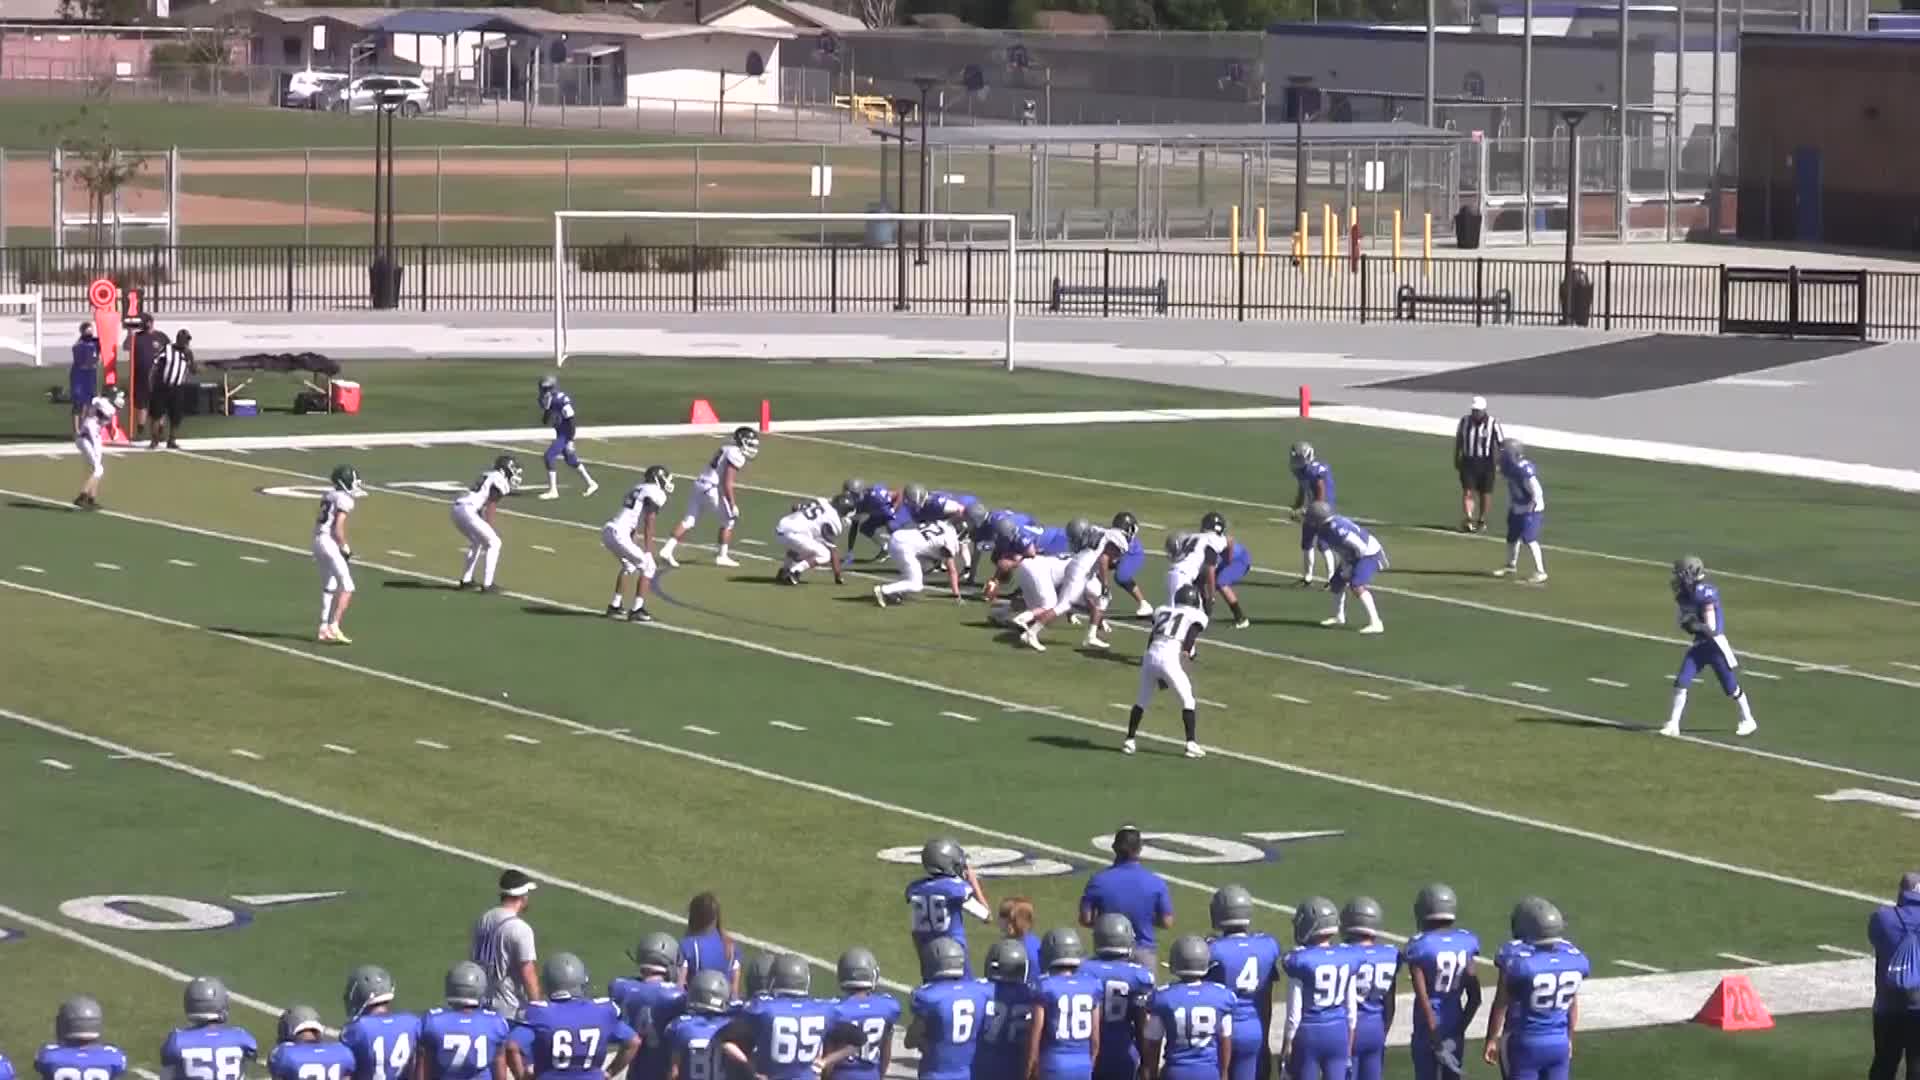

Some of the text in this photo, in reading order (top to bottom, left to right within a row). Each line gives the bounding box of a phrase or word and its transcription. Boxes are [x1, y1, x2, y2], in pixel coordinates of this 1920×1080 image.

[1153, 611, 1184, 637] 21
[1235, 957, 1259, 993] 4
[1313, 964, 1350, 1007] 91
[1435, 951, 1467, 993] 81
[1532, 971, 1583, 1011] 22
[951, 998, 976, 1044] 6
[1056, 993, 1094, 1041] 16
[1104, 980, 1130, 1023] 6
[1725, 986, 1758, 1021] 20
[552, 1028, 602, 1071] 67
[772, 1016, 825, 1064] 65
[1174, 1006, 1217, 1050] 18
[181, 1046, 245, 1080] 58
[372, 1032, 411, 1080] 14
[443, 1033, 488, 1069] 71
